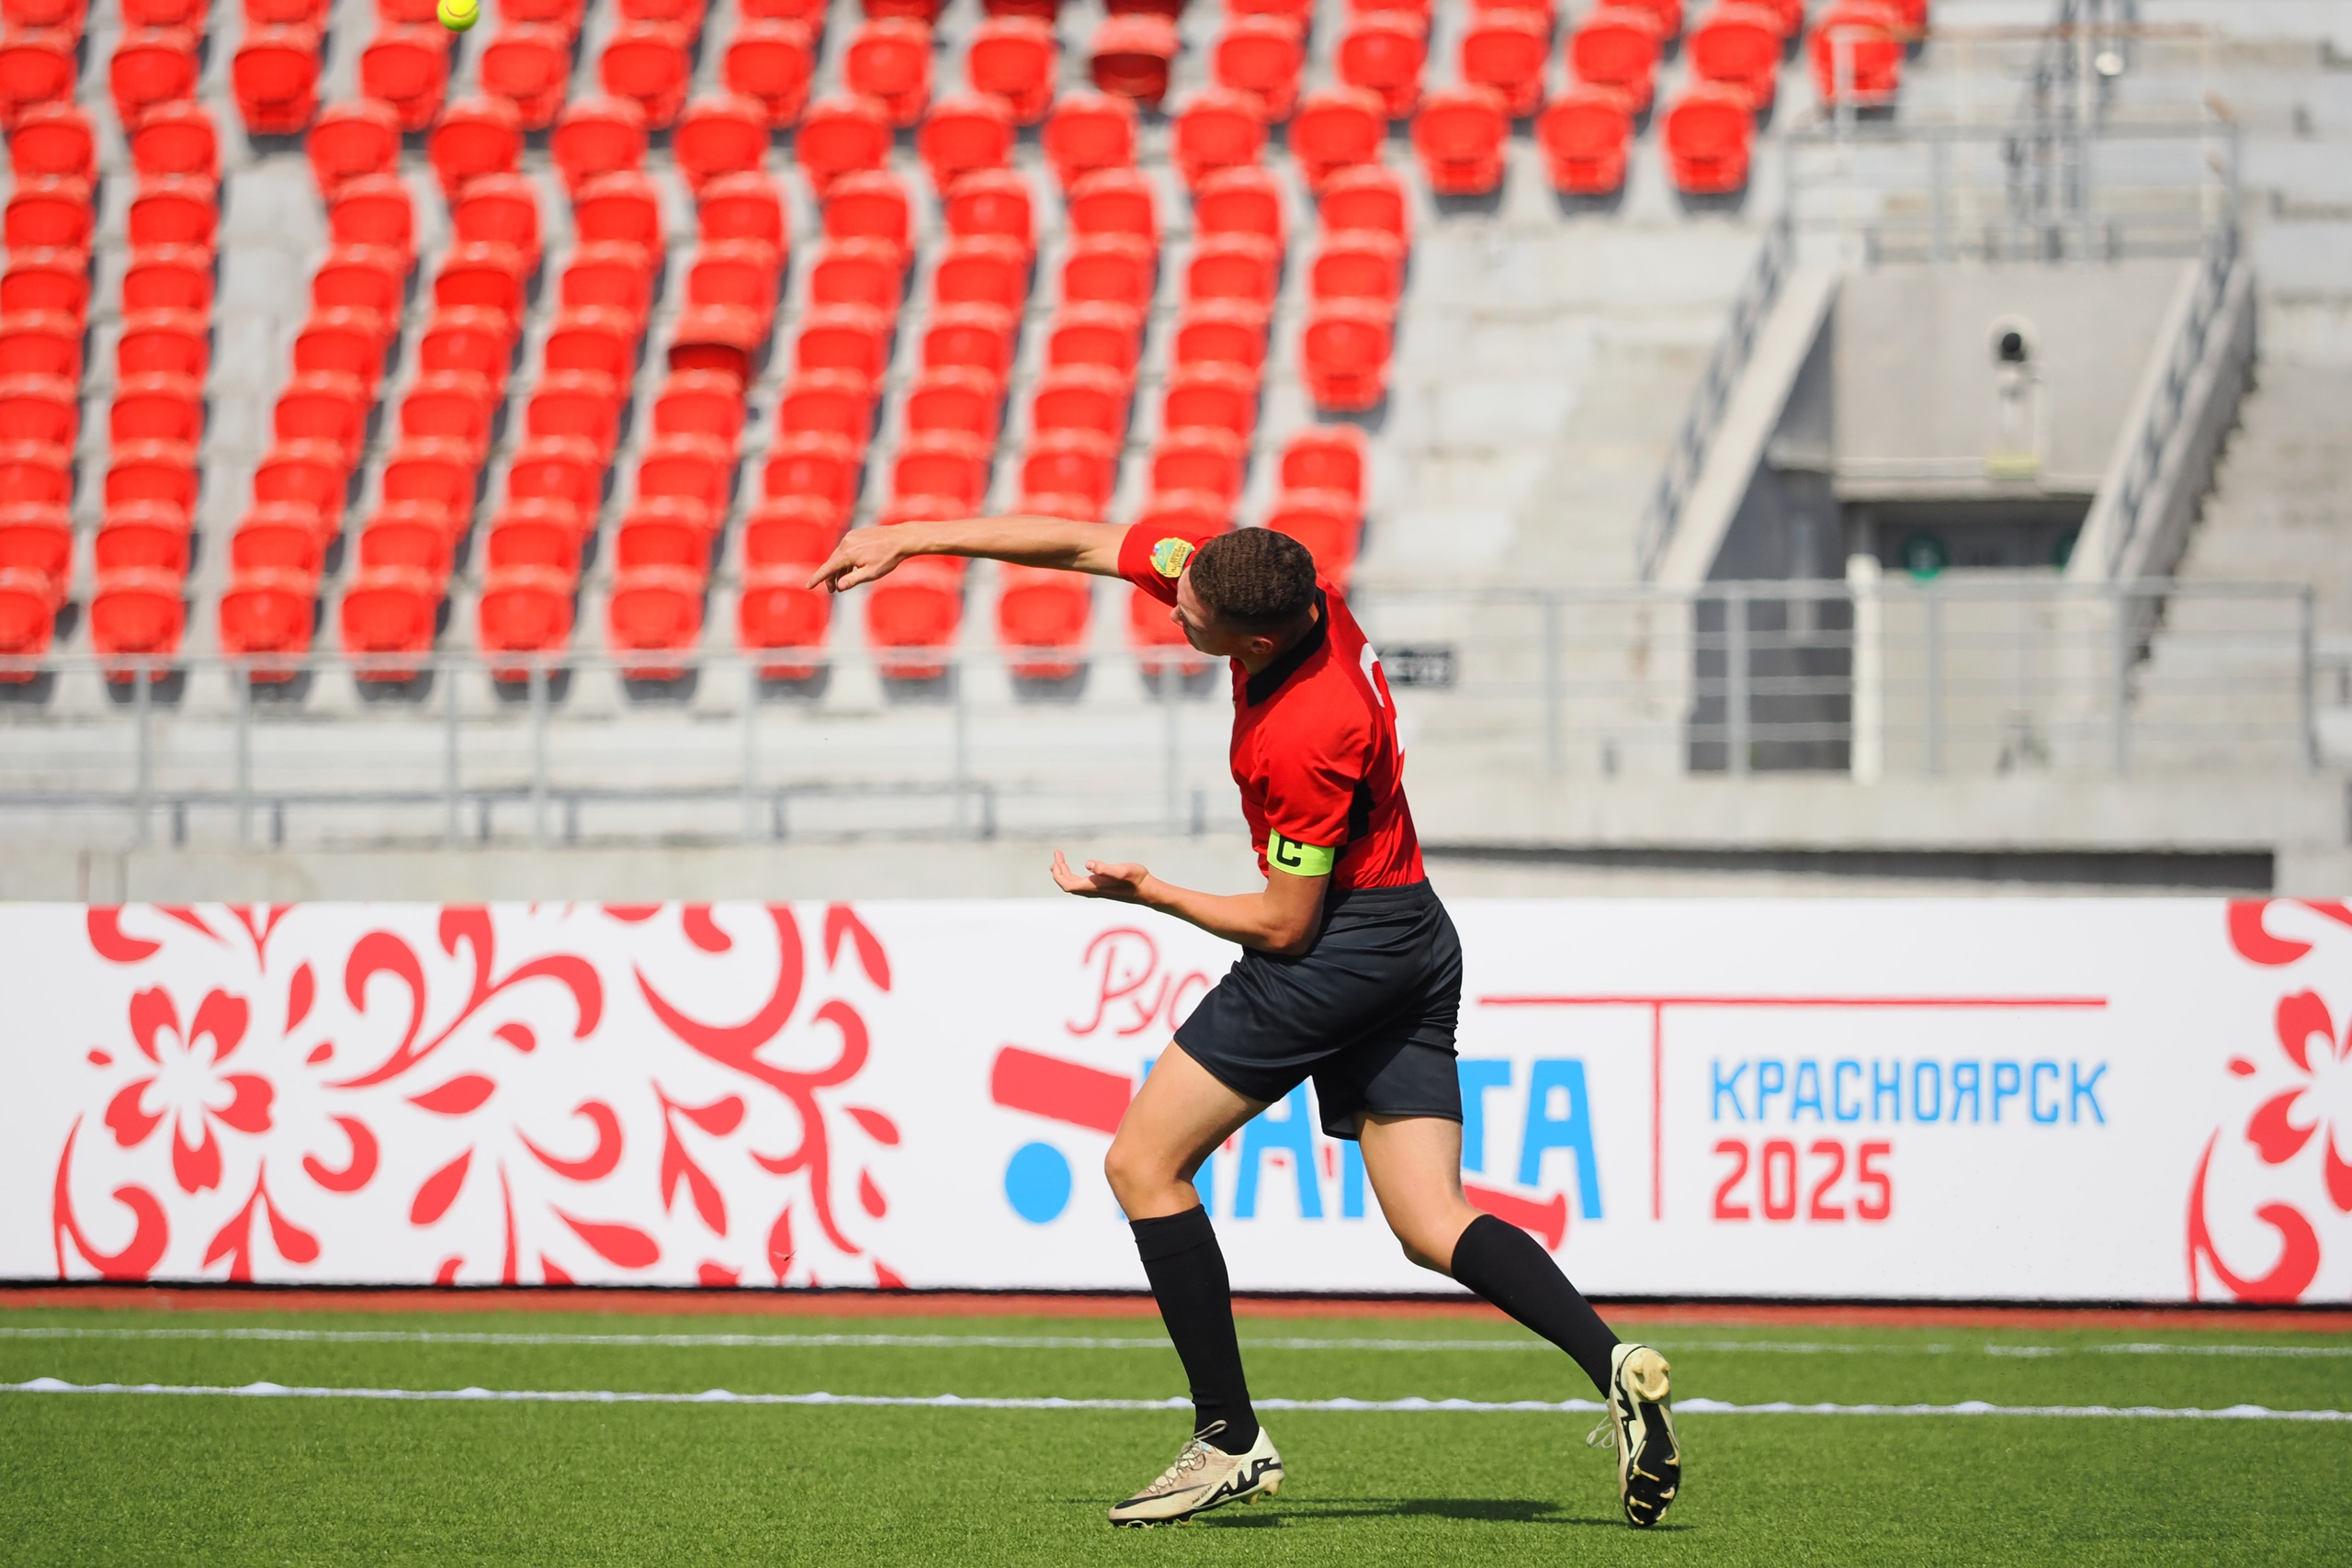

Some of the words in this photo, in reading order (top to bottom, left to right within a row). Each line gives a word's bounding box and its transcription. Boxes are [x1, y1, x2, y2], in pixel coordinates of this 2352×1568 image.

[1276, 834, 1303, 868] C
[1066, 927, 1211, 1037] Рус
[1711, 1058, 2109, 1125] КРАСНОЯРСК
[1121, 1058, 1603, 1220] АТА
[1712, 1137, 1894, 1223] 2025
